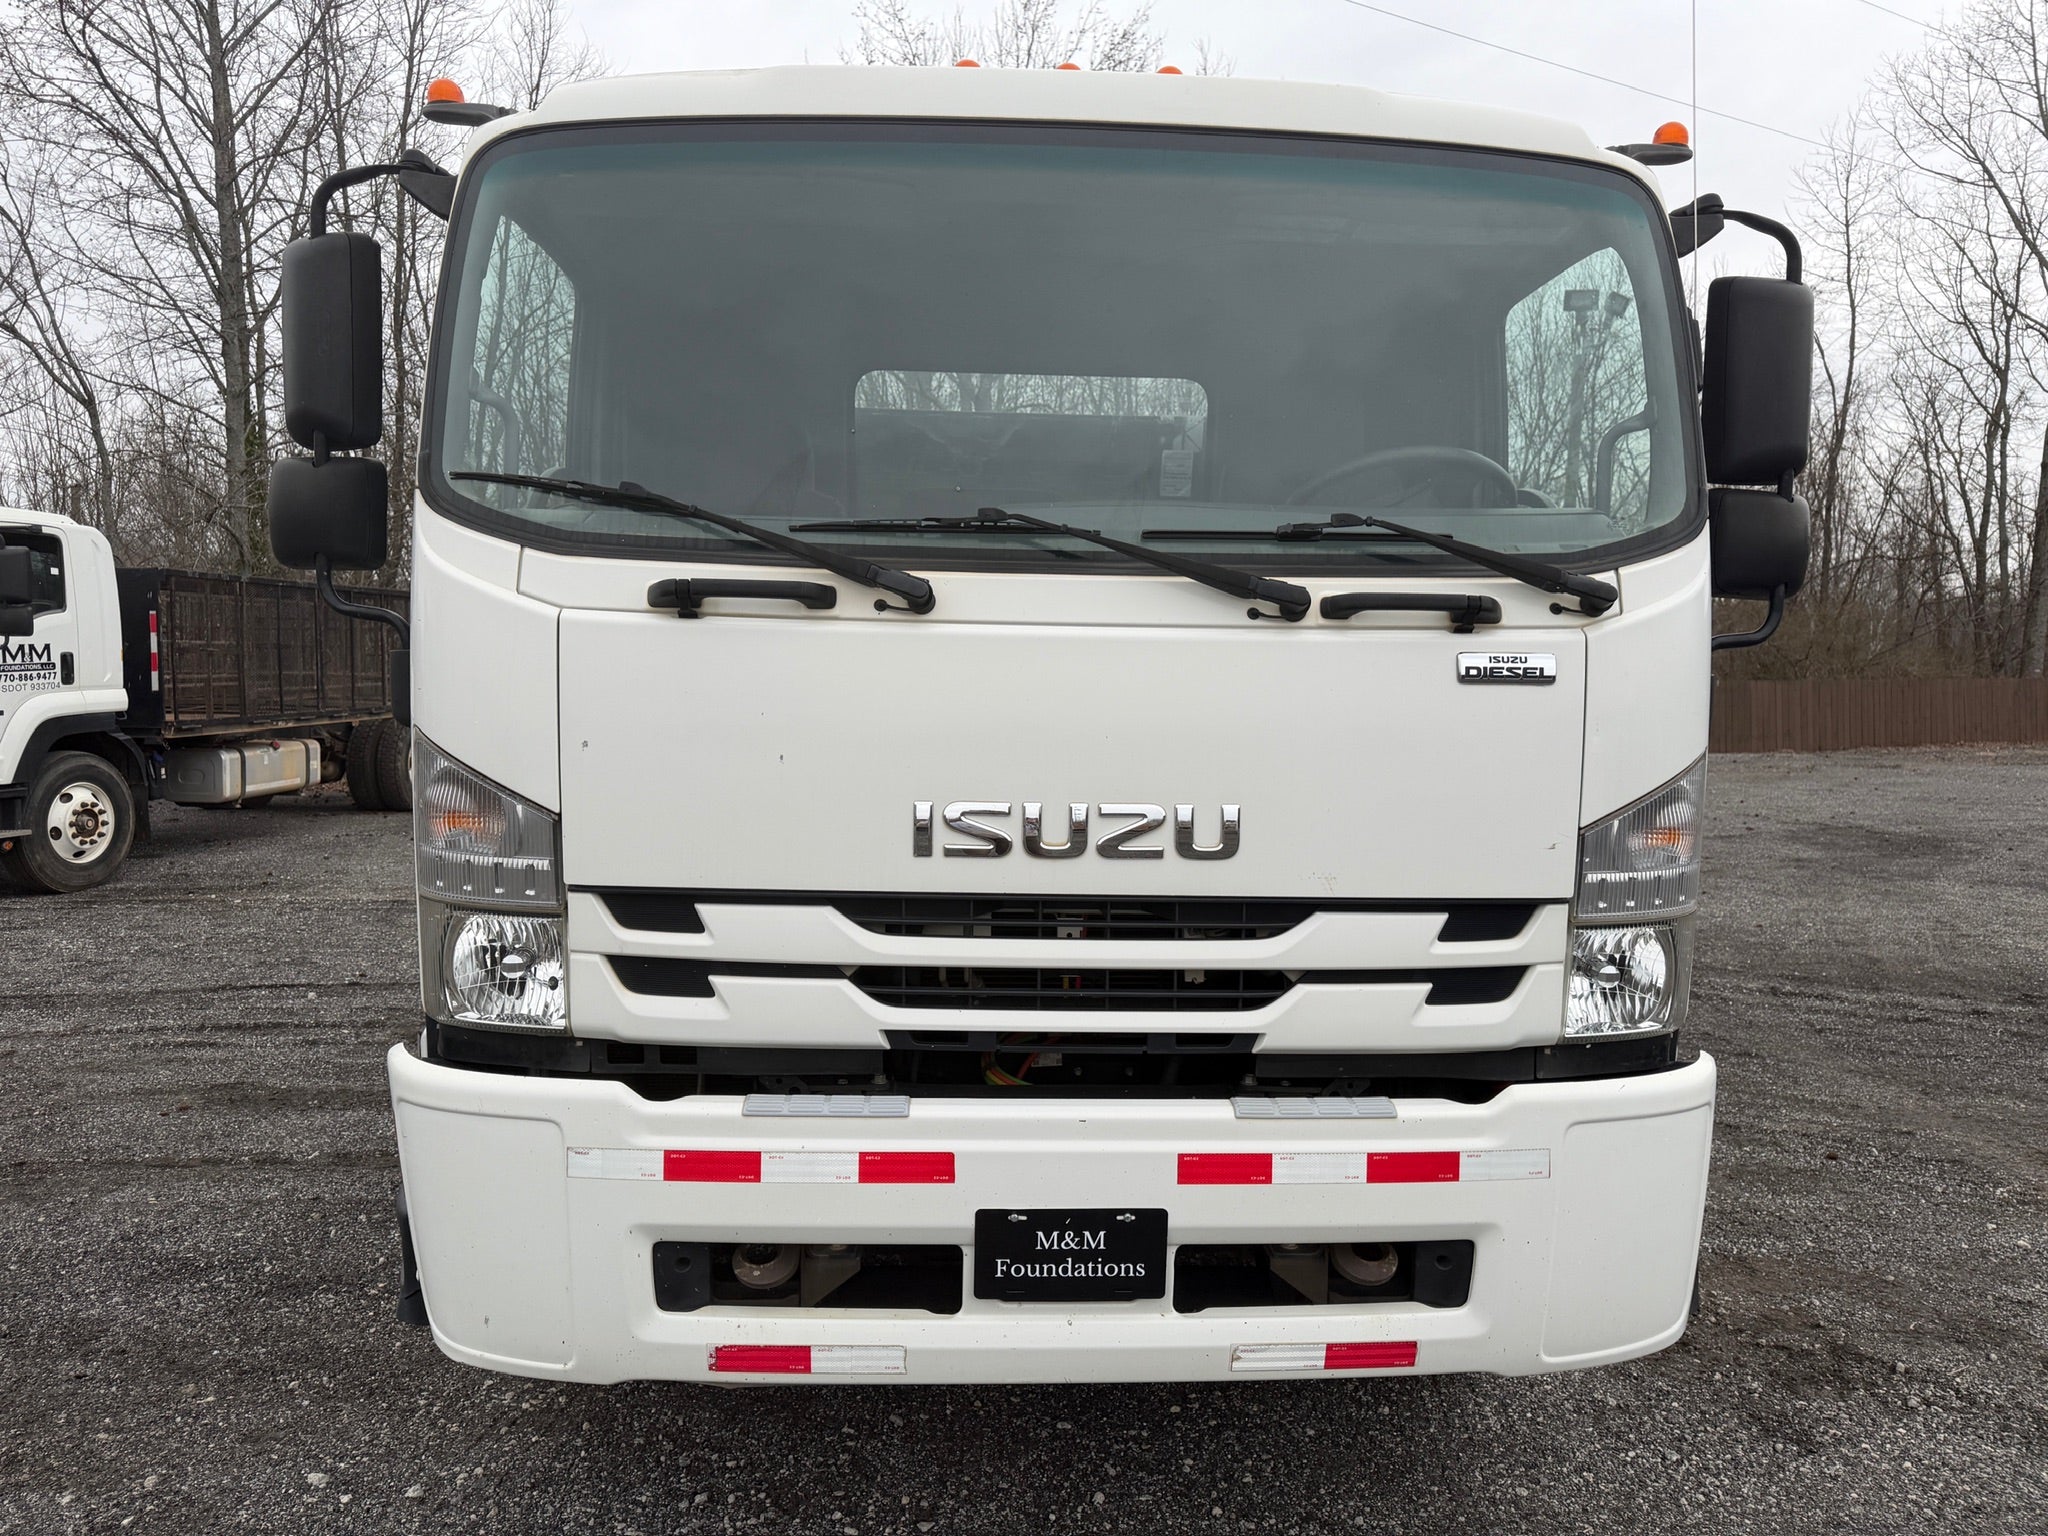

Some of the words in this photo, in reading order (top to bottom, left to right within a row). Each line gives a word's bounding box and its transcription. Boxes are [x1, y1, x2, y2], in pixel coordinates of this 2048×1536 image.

[1488, 656, 1528, 664] ISUZU
[1464, 666, 1554, 680] DIESEL
[30, 681, 61, 691] 933704
[913, 801, 1241, 861] ISUZU
[1035, 1230, 1107, 1250] M&M
[994, 1257, 1146, 1278] Foundations
